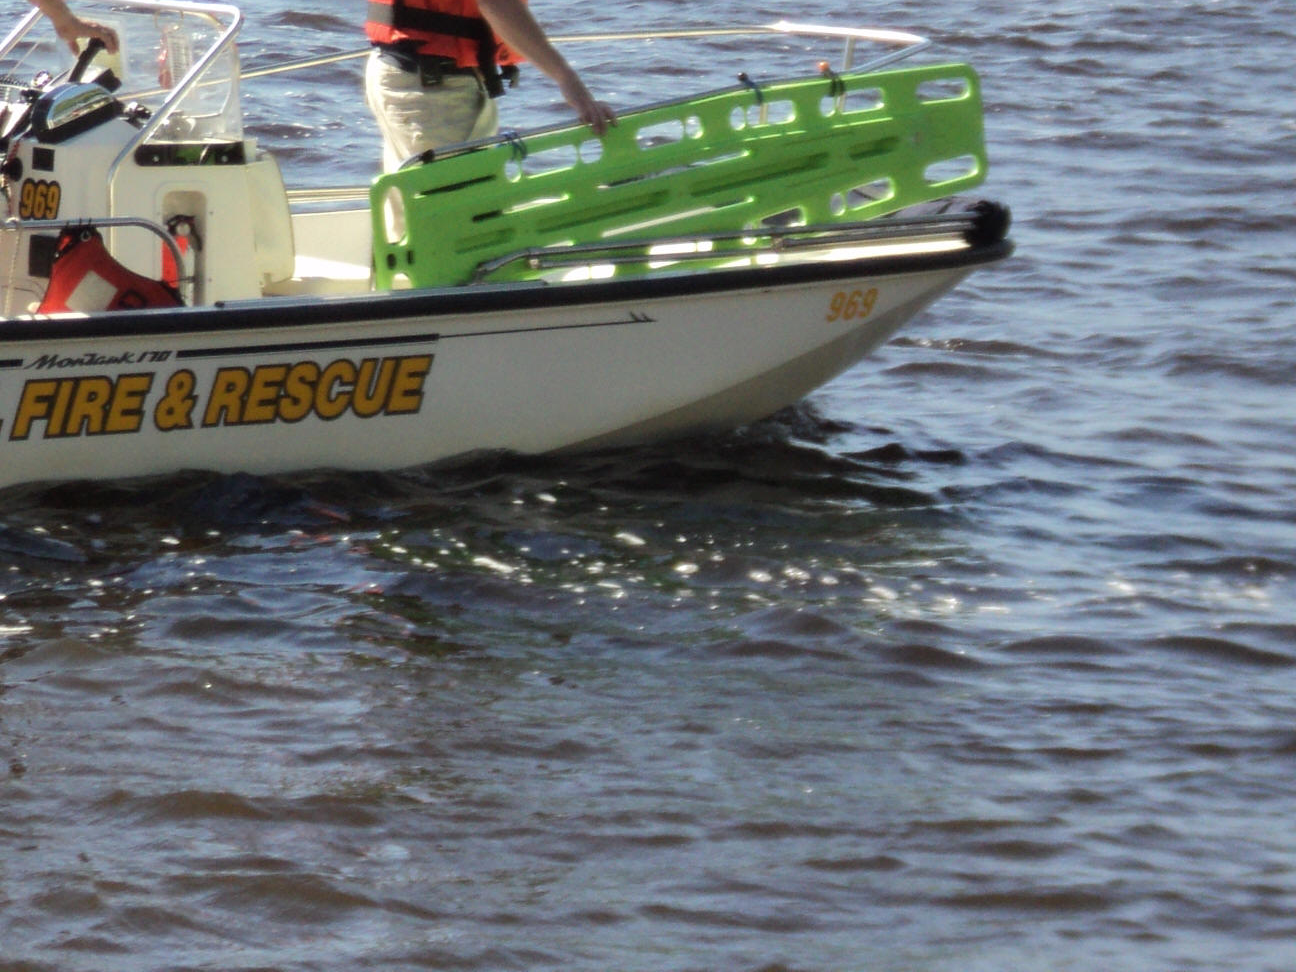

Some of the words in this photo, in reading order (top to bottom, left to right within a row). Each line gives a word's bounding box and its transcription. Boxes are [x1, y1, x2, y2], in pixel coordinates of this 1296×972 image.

[19, 178, 61, 220] 969
[826, 288, 878, 322] 969
[9, 372, 154, 441] FIRE
[154, 368, 196, 431] &
[202, 354, 434, 427] RESCUE
